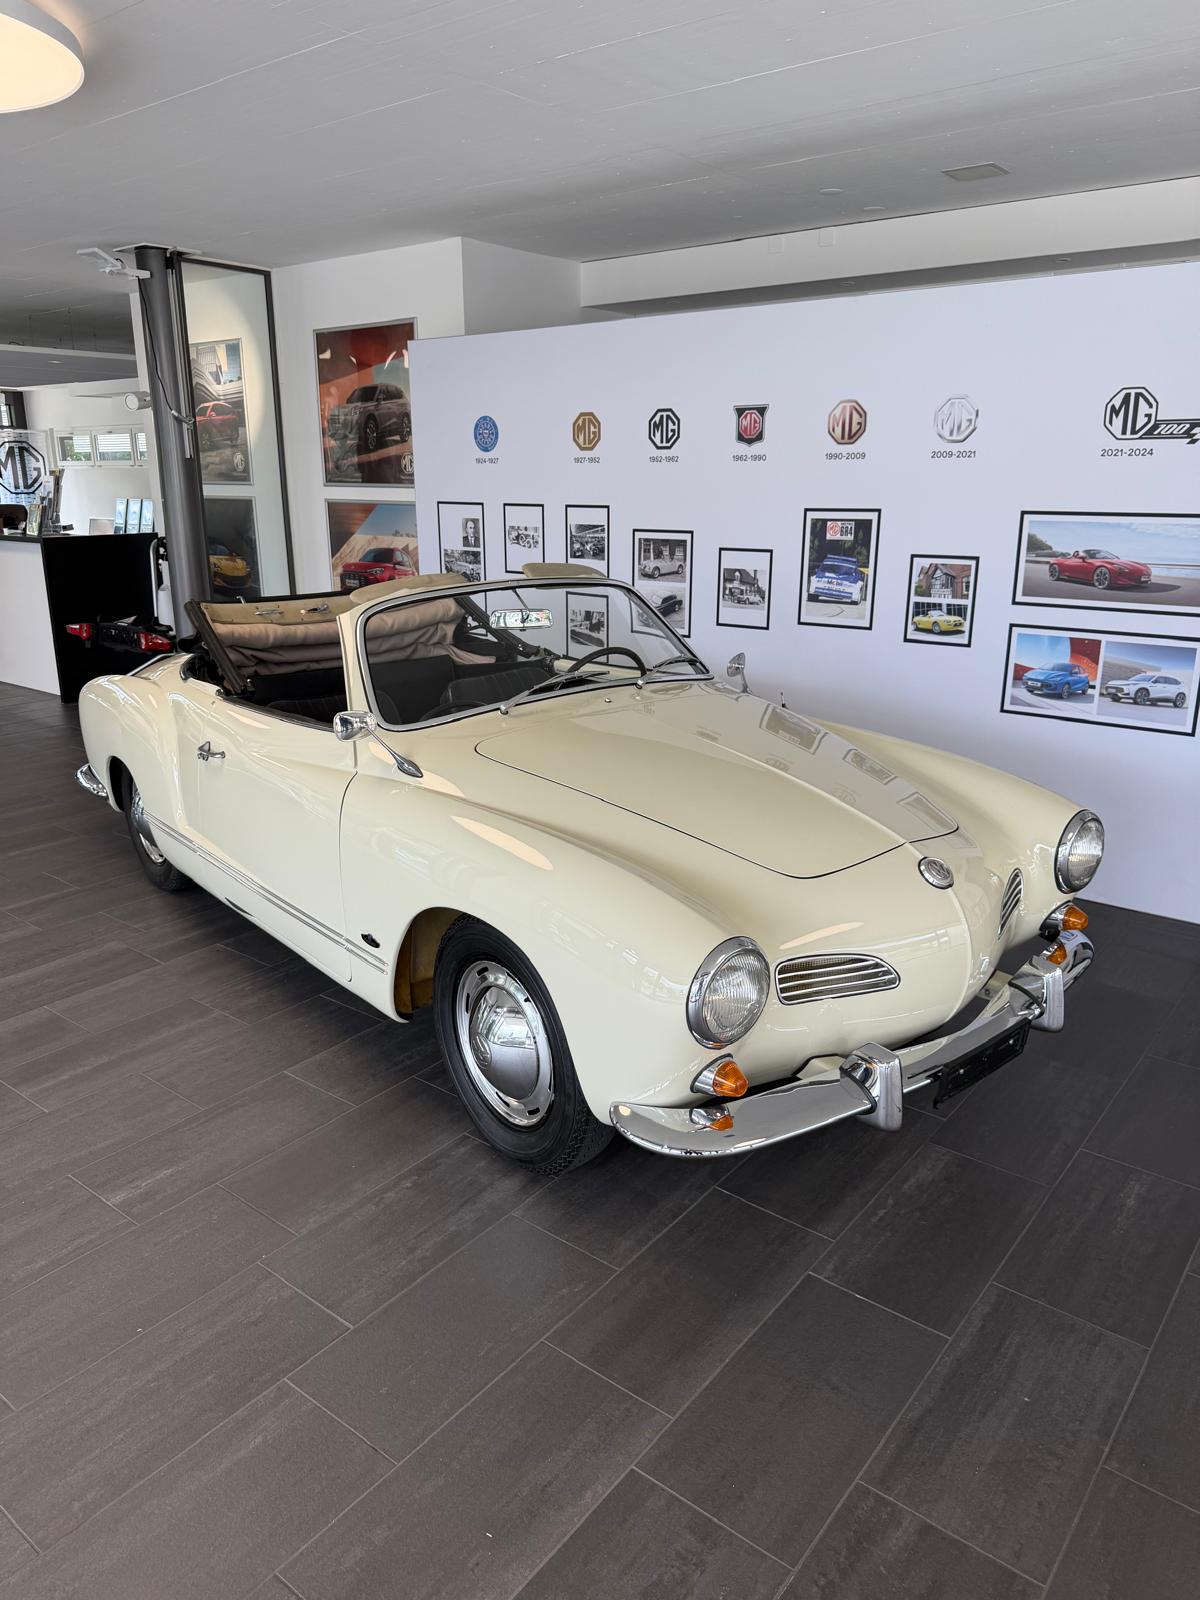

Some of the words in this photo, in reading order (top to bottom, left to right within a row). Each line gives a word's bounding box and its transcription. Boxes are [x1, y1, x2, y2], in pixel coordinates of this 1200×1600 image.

[741, 412, 761, 438] MG
[831, 403, 863, 441] MG
[940, 400, 973, 437] MG
[1107, 391, 1154, 436] MG
[1153, 423, 1190, 435] 100
[575, 416, 599, 447] MG
[651, 413, 677, 445] MG
[573, 456, 601, 464] 1927-1952
[648, 455, 679, 463] 1952-1962
[731, 454, 767, 462] 1962-1990
[825, 451, 866, 461] 1990-2009
[930, 450, 977, 459] 2009-2021
[1100, 447, 1154, 457] 2021-2024
[0, 445, 41, 490] MG
